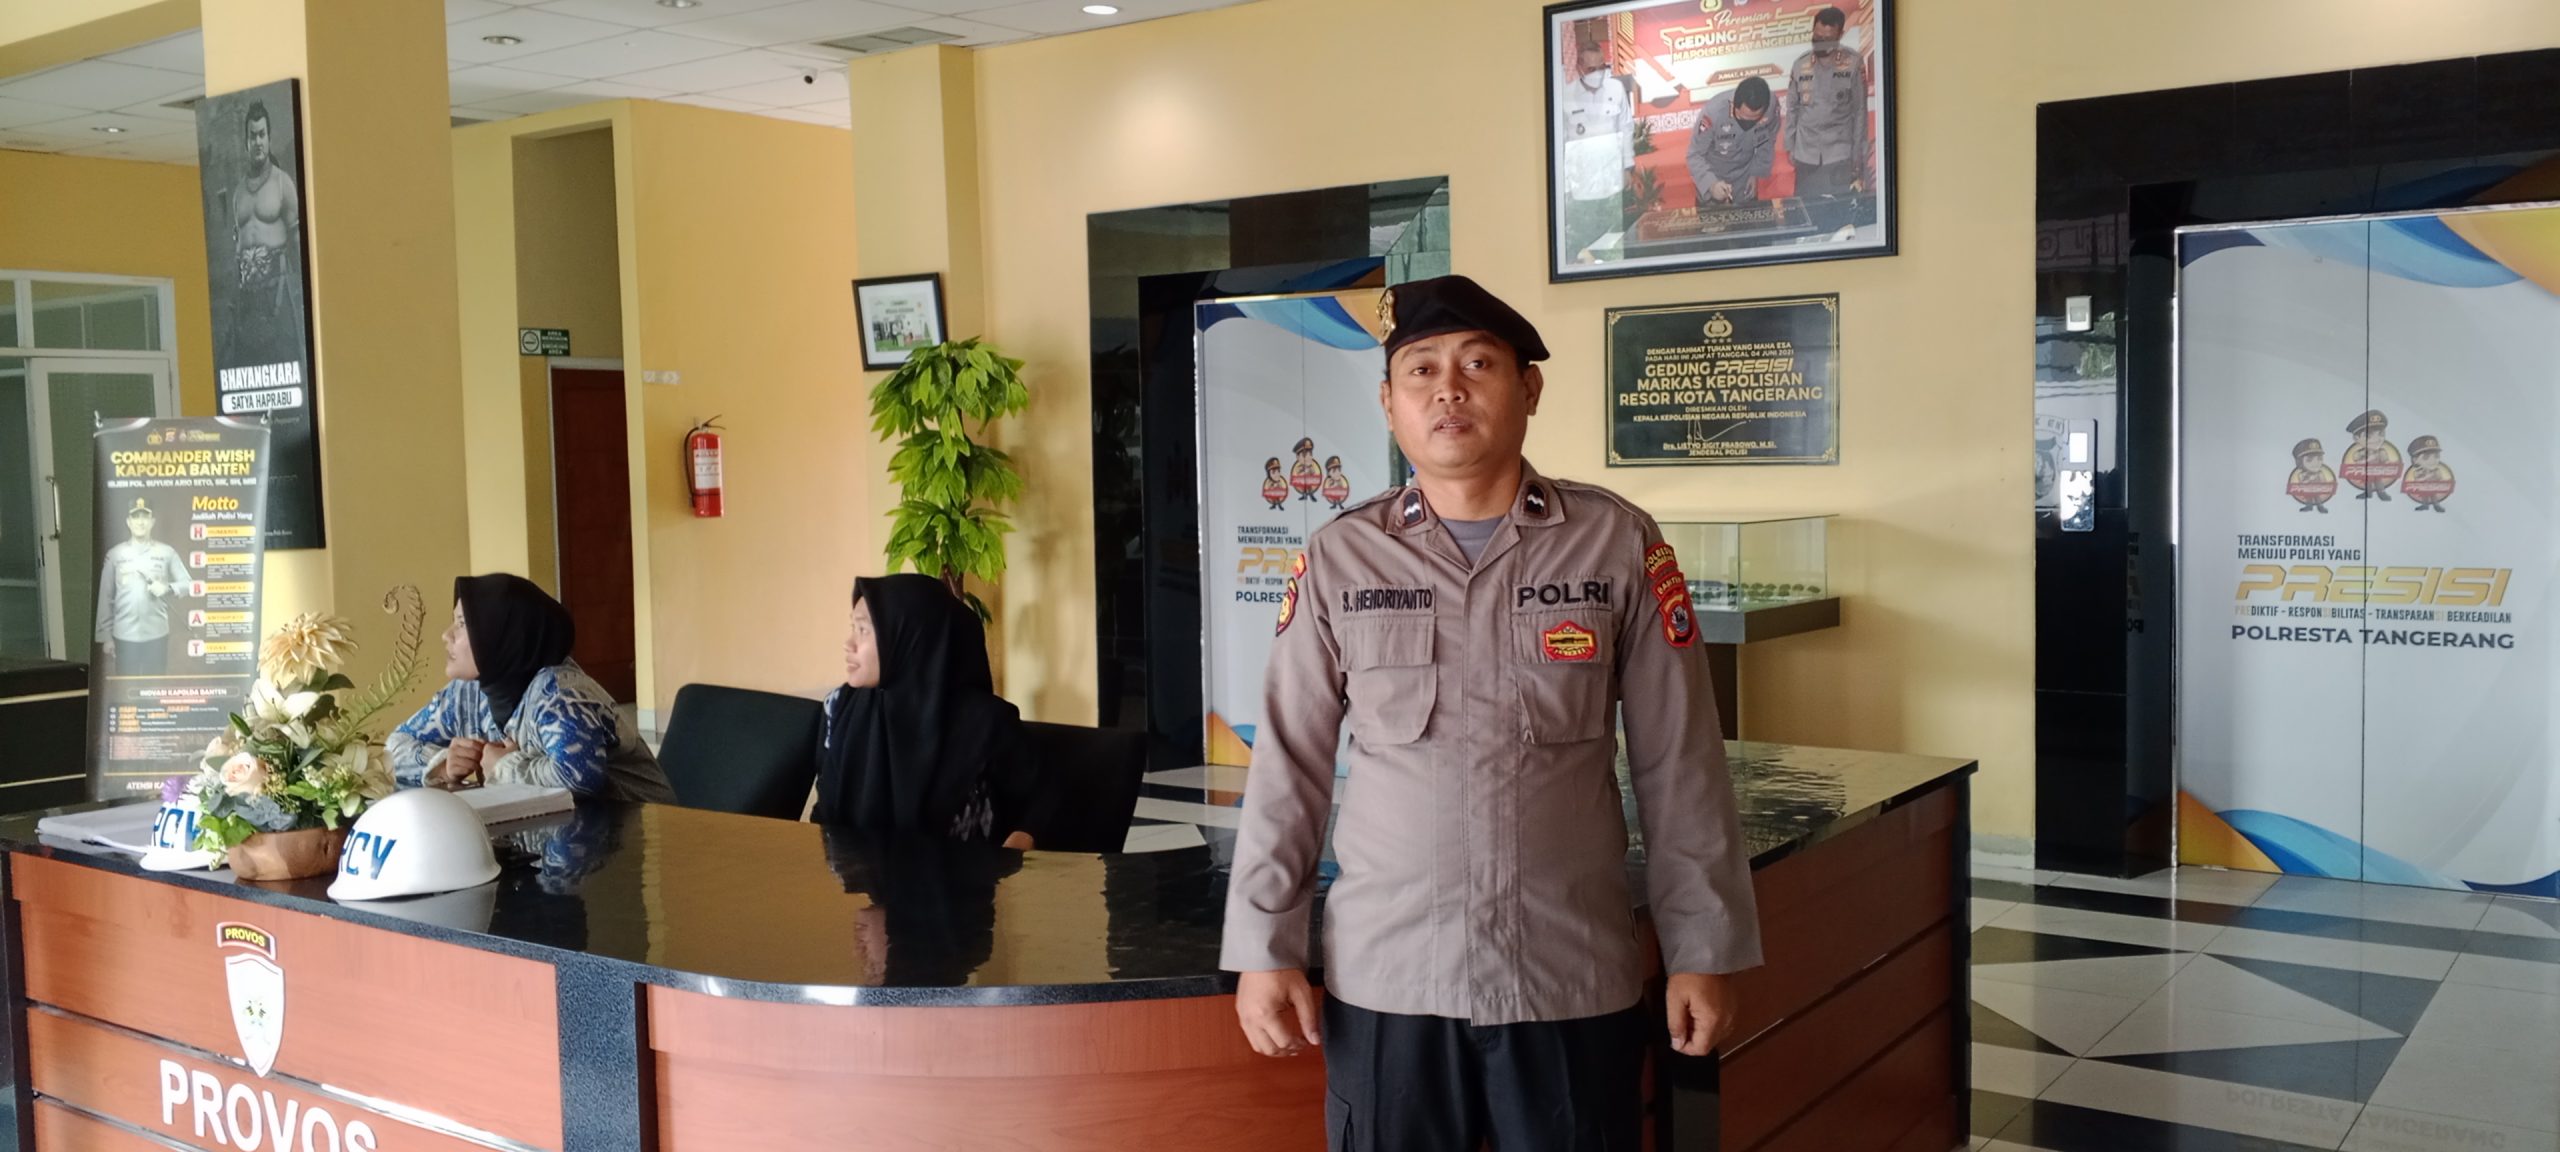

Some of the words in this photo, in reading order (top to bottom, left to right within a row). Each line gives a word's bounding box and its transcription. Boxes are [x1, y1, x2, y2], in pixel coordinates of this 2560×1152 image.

[1714, 9, 1772, 30] Peresmian
[1674, 30, 1738, 50] GEDUNG
[1673, 43, 1749, 61] MAPOLRESTA
[1677, 346, 1705, 354] RAHMAT
[1707, 345, 1732, 353] TUHAN
[1645, 362, 1711, 377] GEDUNG
[1713, 358, 1794, 374] PRESISI
[220, 361, 301, 391] BHAYANGKARA
[1637, 376, 1702, 391] MARKAS
[1706, 372, 1802, 388] KEPOLISIAN
[231, 395, 254, 410] SATYA
[255, 391, 292, 408] HAPRABU
[1619, 391, 1670, 407] RESOR
[1674, 391, 1716, 405] KOTA
[1720, 386, 1823, 403] TANGERANG
[1633, 414, 1660, 422] KEPALA
[1660, 413, 1700, 421] KEPOLISIAN
[1701, 412, 1730, 420] NEGARA
[1731, 411, 1765, 419] REPUBLIK
[1767, 410, 1807, 418] INDONESIA
[1685, 405, 1727, 413] DIRESMIKAN
[110, 450, 212, 464] COMMANDER
[214, 449, 256, 463] WISH
[1688, 449, 1723, 457] JENDERAL
[115, 464, 187, 477] KAPOLDA
[189, 463, 251, 476] BANTEN
[191, 496, 239, 511] Motto
[191, 512, 217, 520] Jadilah
[217, 512, 236, 520] Polisi
[236, 512, 254, 521] Yang
[194, 527, 203, 538] H
[1237, 526, 1289, 534] TRANSFORMASI
[1237, 536, 1264, 544] MENUJU
[1265, 536, 1284, 544] POLRI
[1285, 536, 1303, 545] YANG
[2237, 534, 2335, 547] TRANSFORMASI
[2237, 548, 2287, 560] MENUJU
[2289, 549, 2325, 560] POLRI
[2327, 549, 2361, 561] YANG
[2235, 564, 2513, 607] PRESISI
[1236, 591, 1286, 603] POLRES
[1356, 588, 1433, 612] HENDRIYANTO
[1517, 580, 1609, 608] POLRI
[192, 613, 202, 625] A
[2447, 610, 2512, 624] BERKEADILAN
[2231, 624, 2352, 644] POLRESTA
[2359, 628, 2515, 649] TANGERANG
[192, 643, 200, 654] T
[139, 689, 167, 697] INOVASI
[168, 688, 199, 696] KAPOLDA
[200, 688, 227, 696] BANTEN
[126, 782, 153, 790] ATENSI
[225, 927, 266, 948] PROVOS
